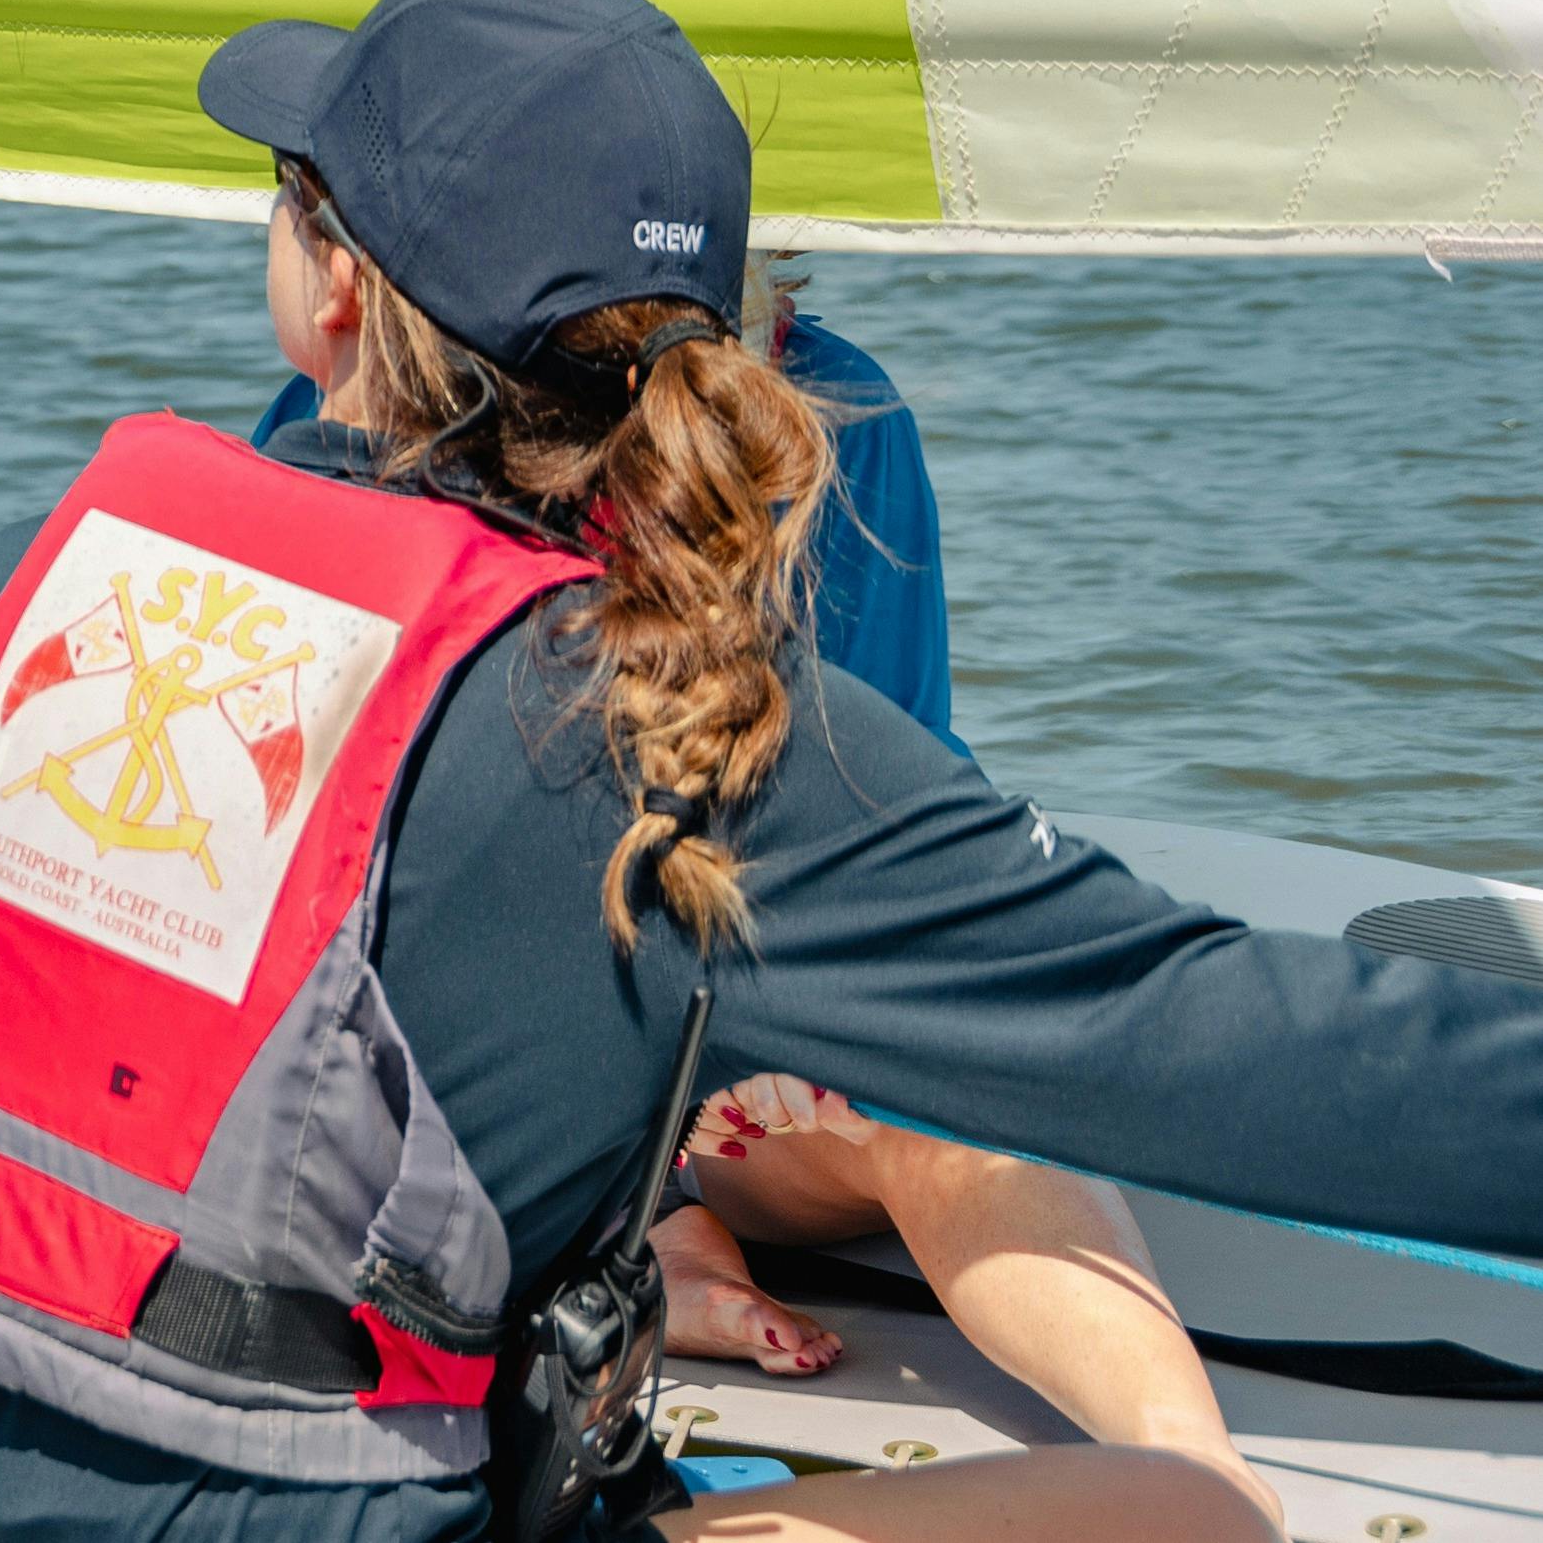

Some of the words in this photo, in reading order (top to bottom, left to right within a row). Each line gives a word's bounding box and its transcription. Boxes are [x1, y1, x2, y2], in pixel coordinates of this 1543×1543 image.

[632, 219, 705, 255] CREW
[31, 878, 83, 913] COAST
[92, 910, 182, 959] AUSTRALIA
[90, 874, 162, 923] YACHT
[163, 908, 224, 949] CLUB
